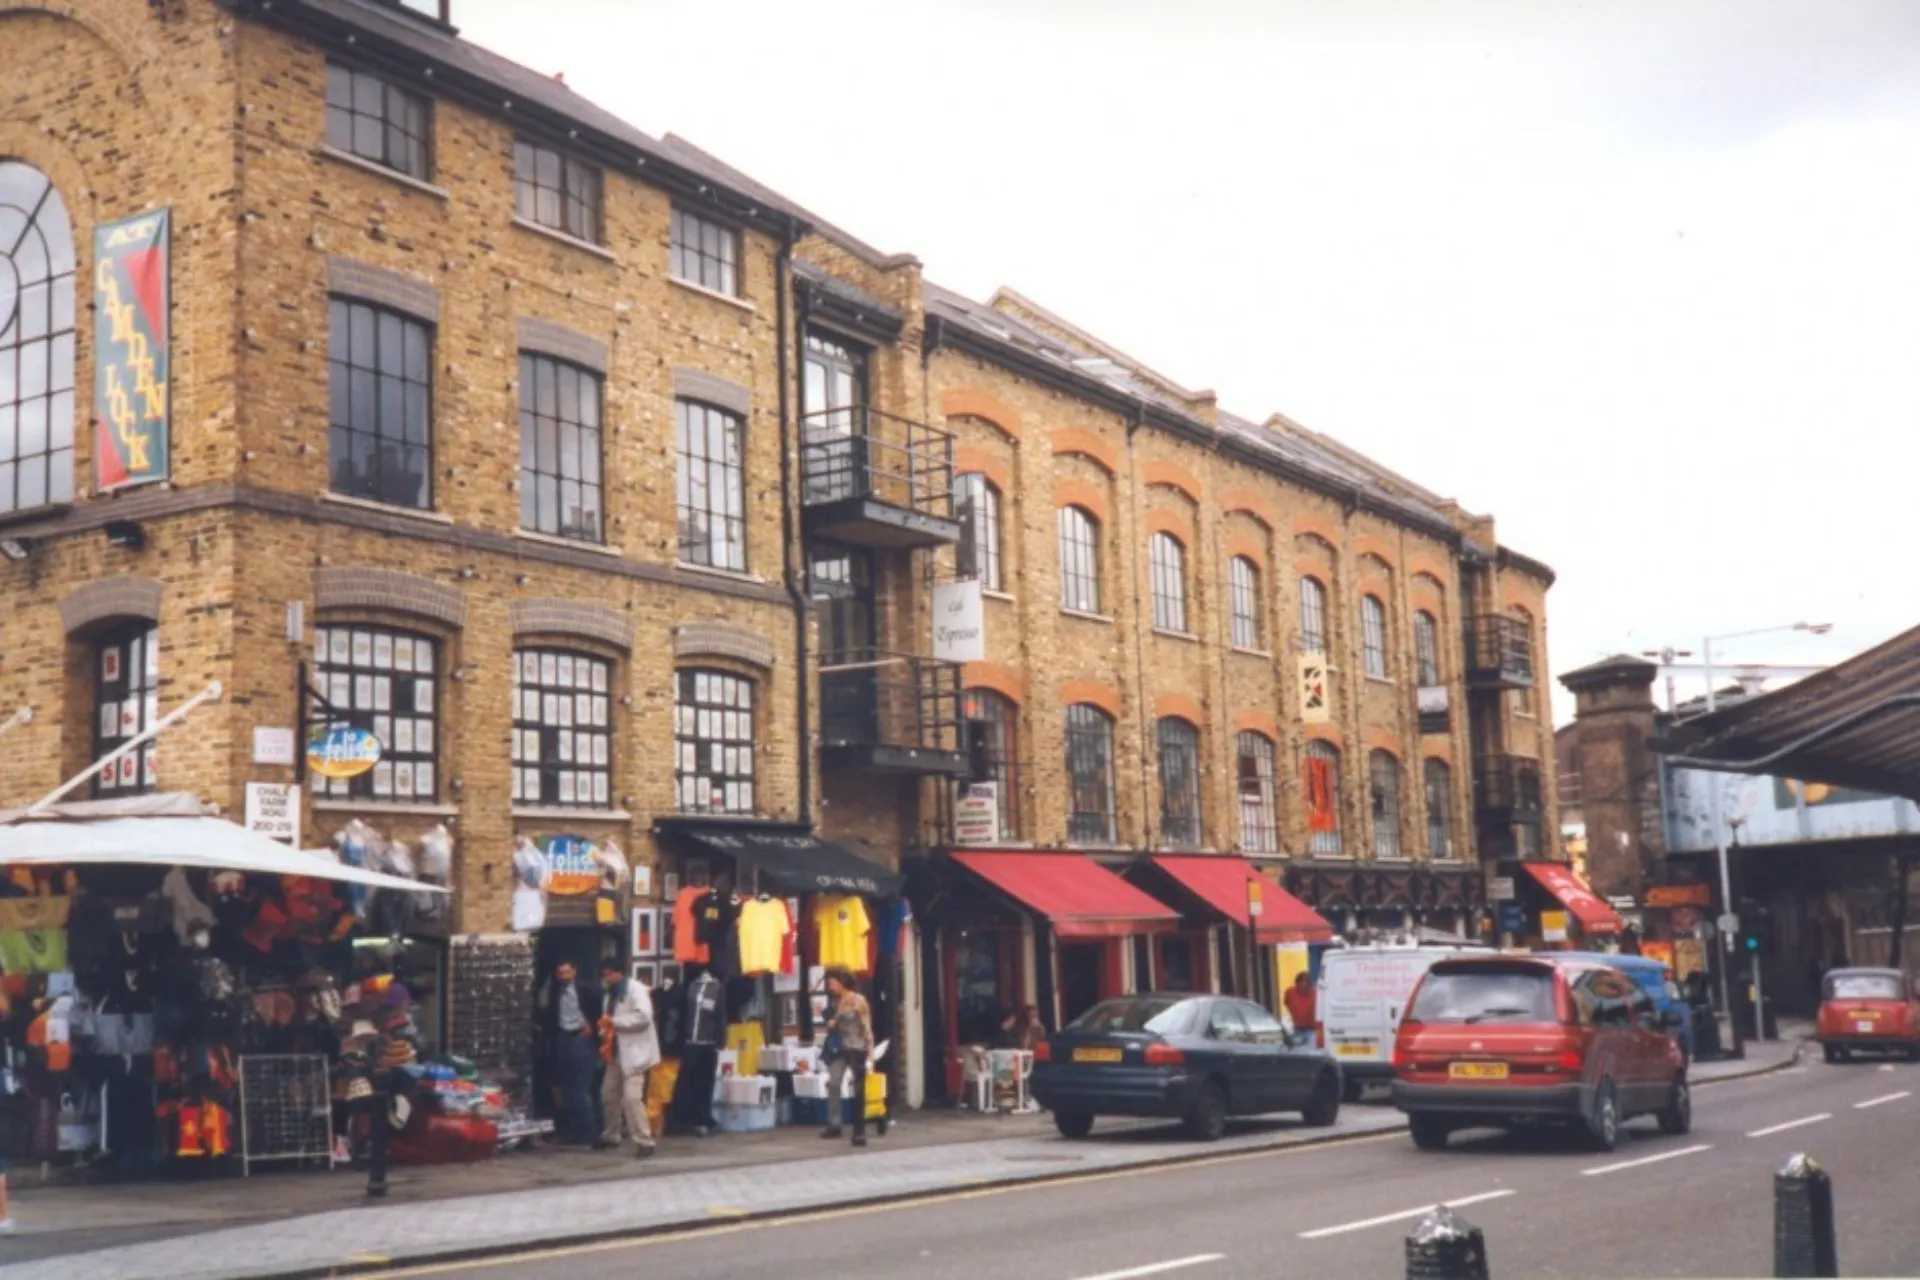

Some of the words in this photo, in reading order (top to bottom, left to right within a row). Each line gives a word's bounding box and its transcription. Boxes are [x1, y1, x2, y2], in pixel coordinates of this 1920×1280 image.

[98, 257, 166, 420] CAMDEN
[105, 364, 150, 471] LOCK
[256, 786, 289, 797] CHALK
[260, 797, 288, 806] FARM
[260, 808, 287, 818] ROAD
